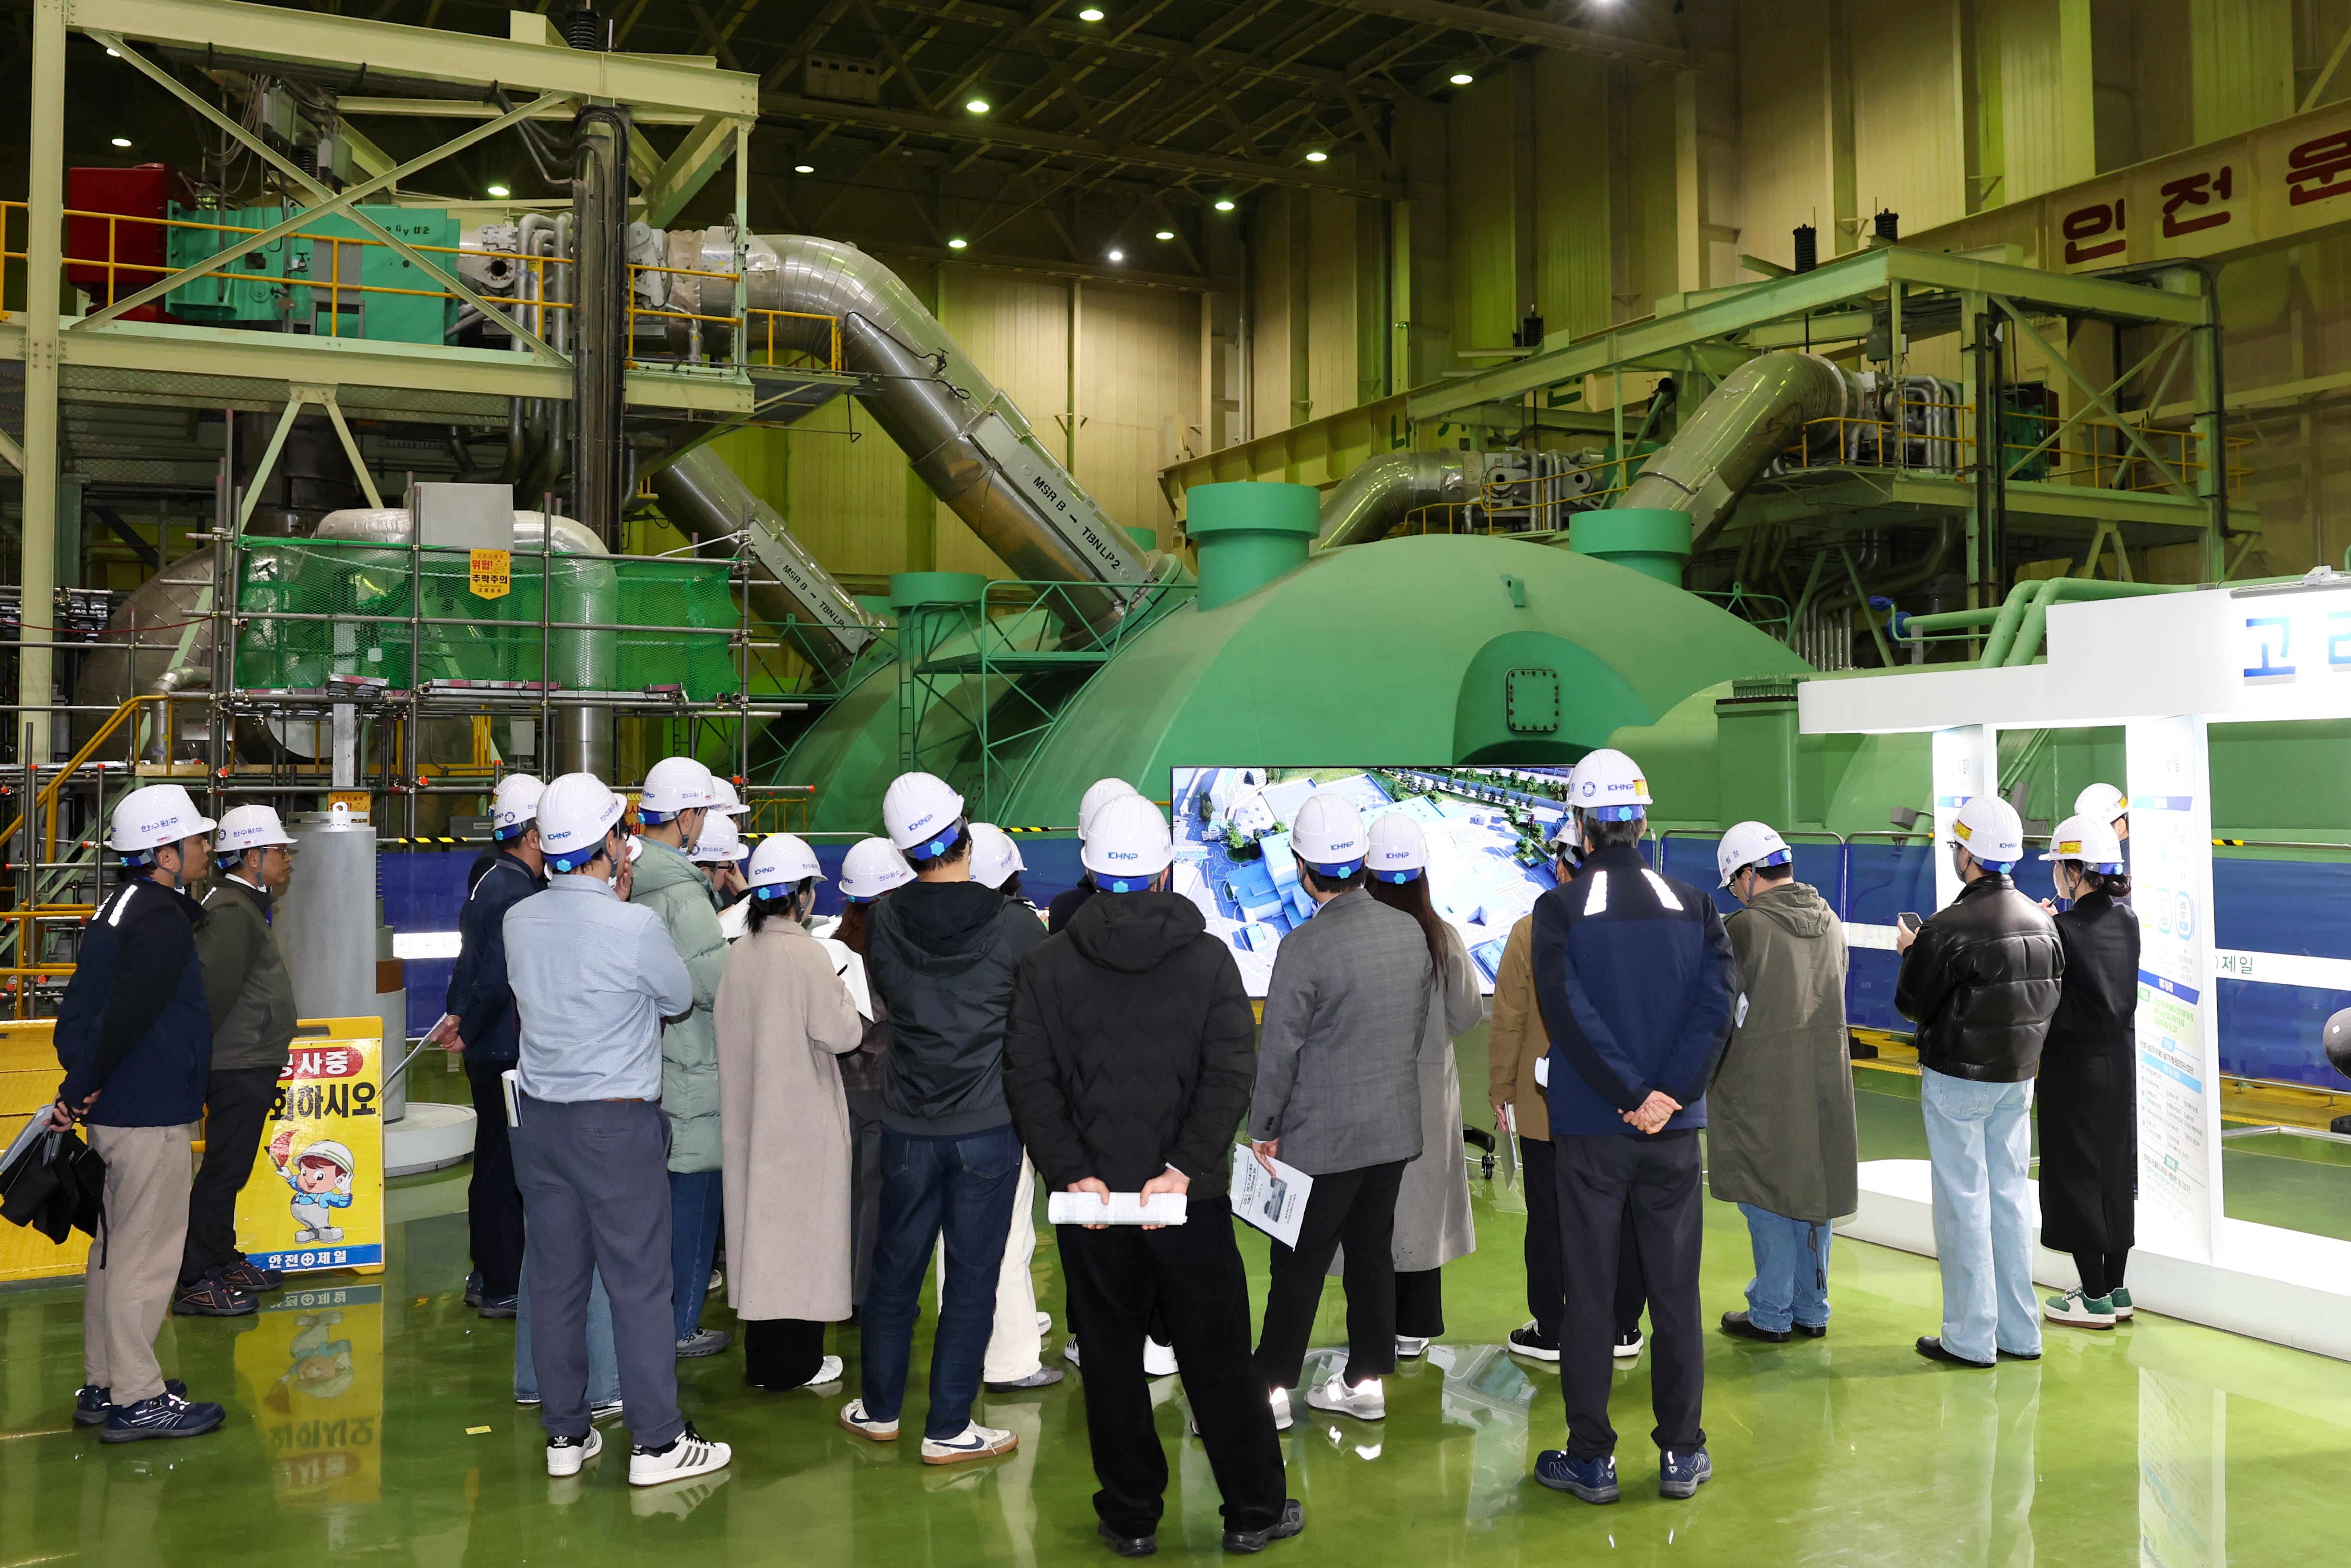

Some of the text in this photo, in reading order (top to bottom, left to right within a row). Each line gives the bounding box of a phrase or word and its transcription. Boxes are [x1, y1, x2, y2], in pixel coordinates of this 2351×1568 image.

[1033, 476, 1057, 502] MSR
[1056, 500, 1066, 511] B
[472, 560, 493, 571] 위험!
[472, 574, 508, 584] 추락주의
[783, 565, 801, 583] MSR
[800, 582, 808, 590] B
[1608, 783, 1634, 791] KHNP
[908, 814, 933, 832] KHNP
[547, 831, 571, 840] KHNP
[1331, 841, 1354, 851] KHNP
[1108, 852, 1138, 860] KHNP
[755, 867, 775, 875] KHNP
[2222, 955, 2252, 975] 제일
[268, 1250, 347, 1268] 안전 제일
